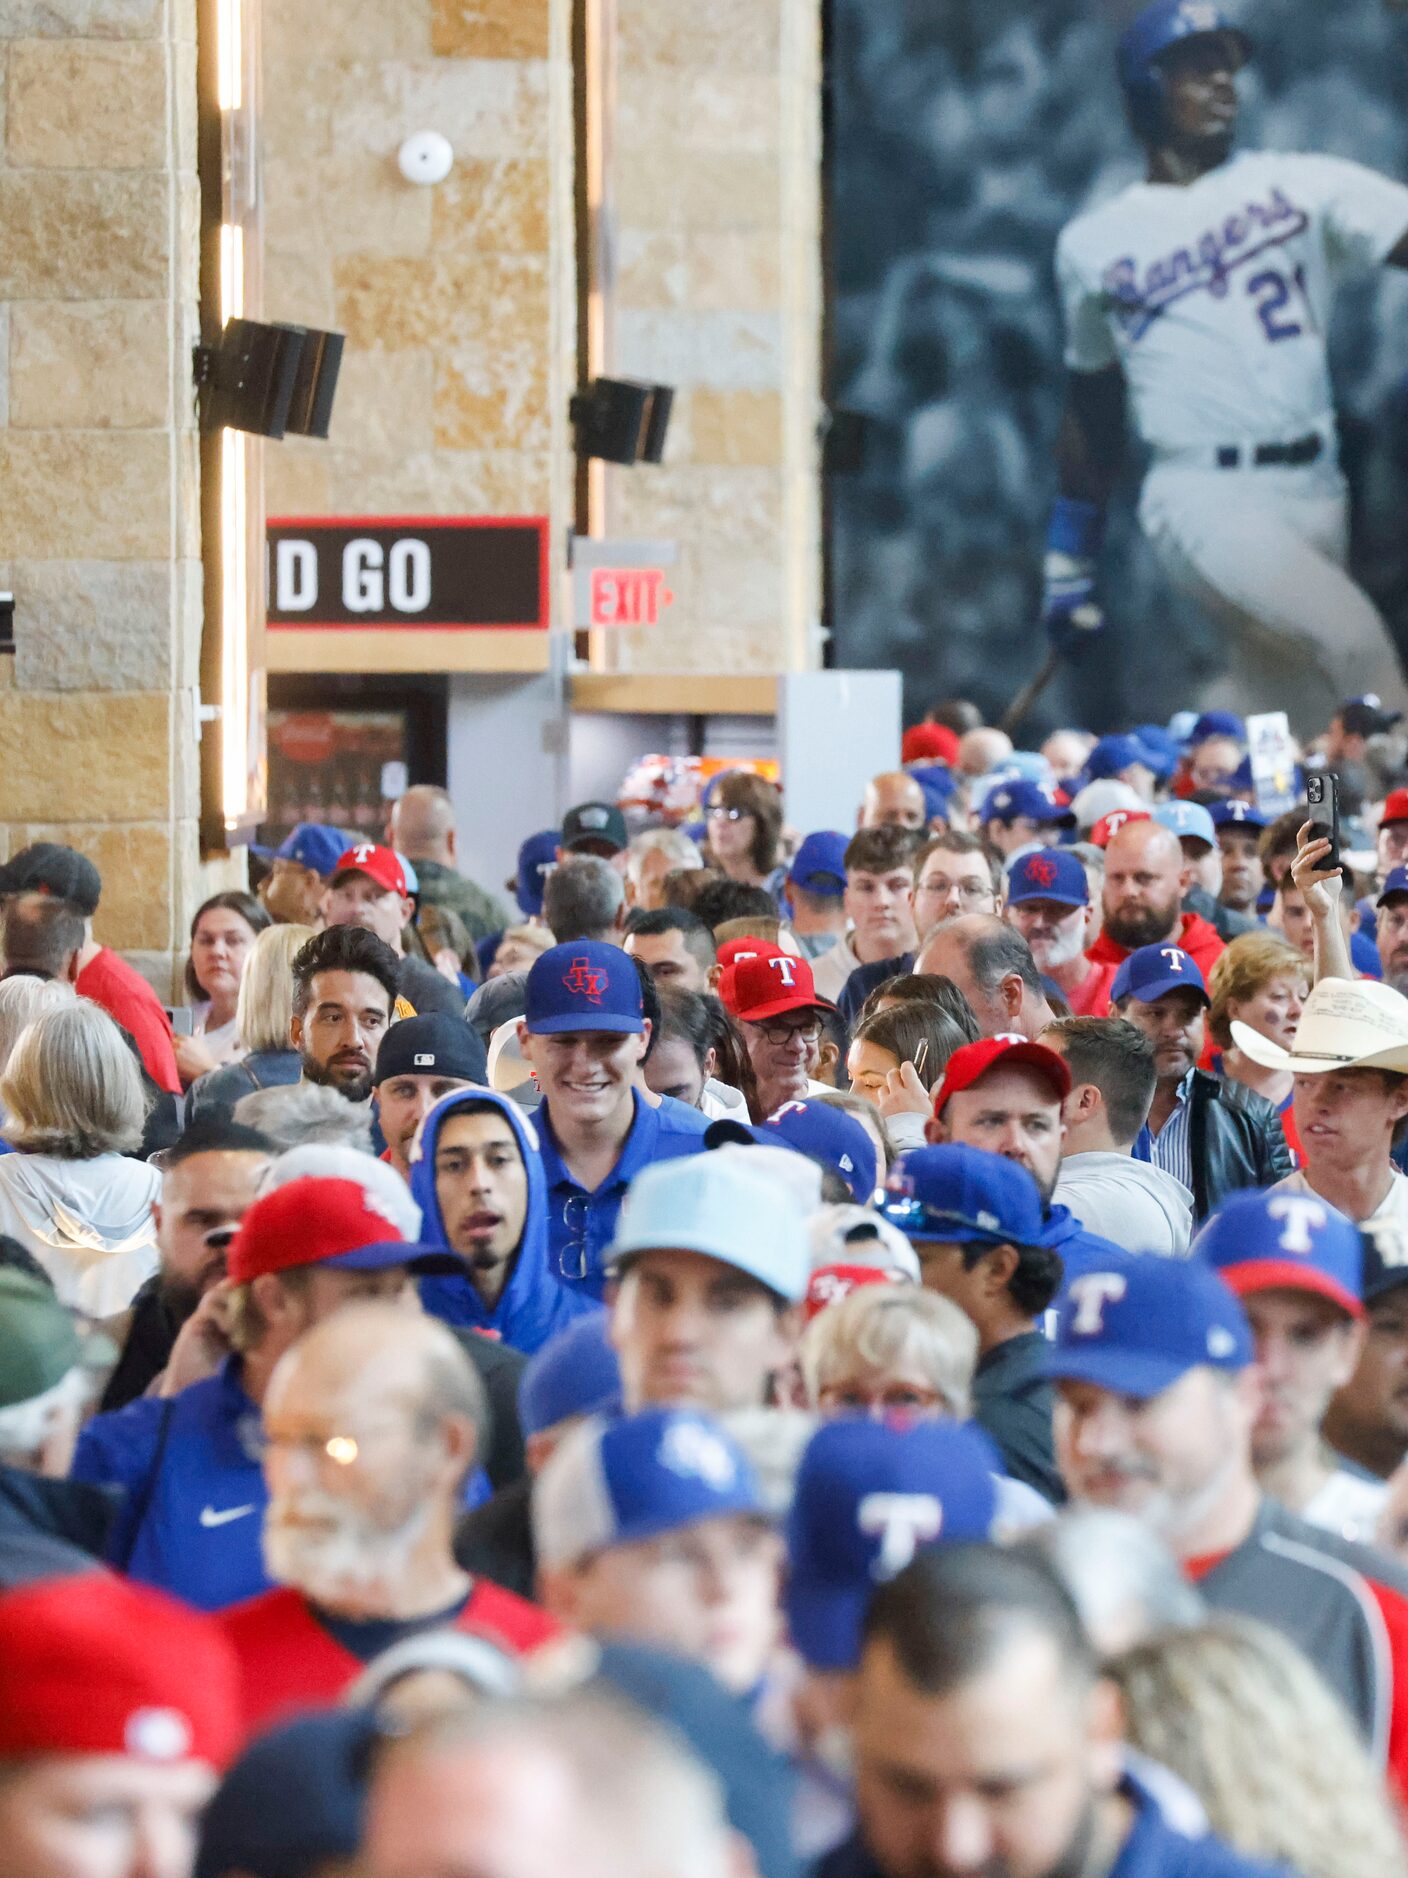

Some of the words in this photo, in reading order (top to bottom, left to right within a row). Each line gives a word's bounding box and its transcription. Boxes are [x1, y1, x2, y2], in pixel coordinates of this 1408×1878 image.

[1102, 186, 1308, 342] Rangers
[264, 539, 318, 612] D
[342, 538, 431, 613] GO
[591, 568, 664, 625] EXIT
[1106, 812, 1128, 837] T
[1169, 804, 1193, 828] T
[1226, 799, 1250, 821] T
[353, 844, 375, 863] T
[768, 957, 797, 987] T
[1161, 948, 1185, 971] T
[1268, 1197, 1327, 1254] T
[1069, 1271, 1128, 1335] T
[857, 1491, 944, 1583] T
